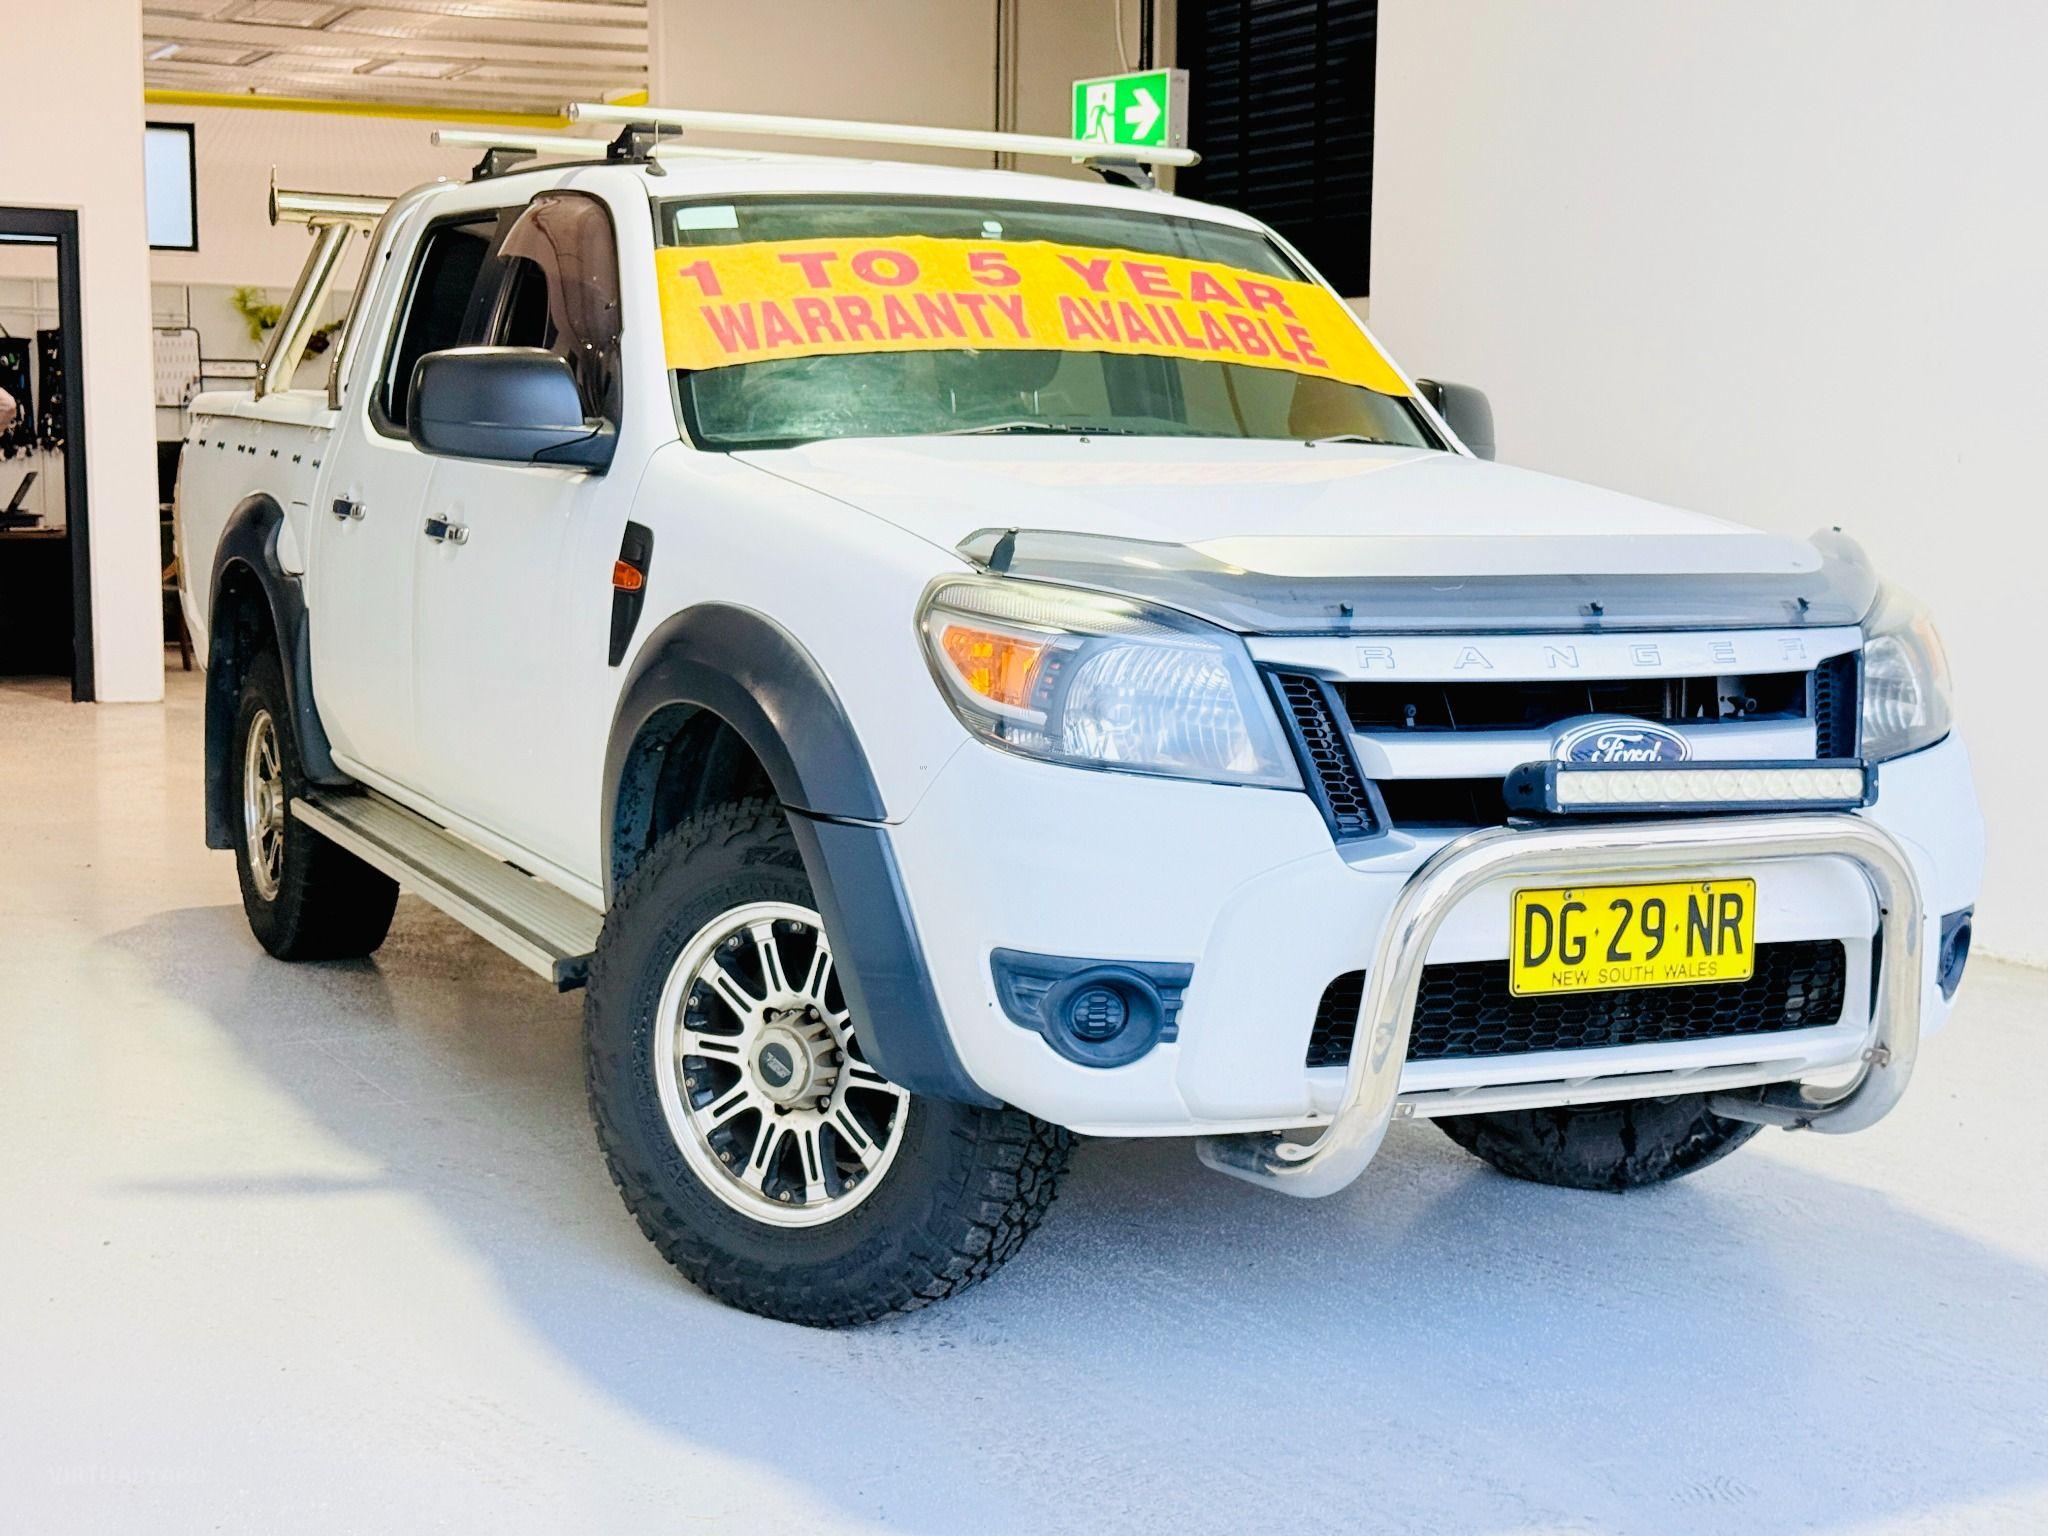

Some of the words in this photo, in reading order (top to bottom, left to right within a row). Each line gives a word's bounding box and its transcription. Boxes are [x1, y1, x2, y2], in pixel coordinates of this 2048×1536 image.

[679, 260, 722, 296] 1
[778, 251, 920, 288] TO
[968, 251, 1021, 286] 5
[1057, 256, 1301, 320] YEAR
[700, 292, 1031, 354] WARRANTY
[1059, 295, 1330, 370] AVAILABLE
[1355, 637, 1808, 670] RANGER
[1524, 902, 1588, 968] DG
[1606, 898, 1666, 962] 29
[1686, 893, 1744, 957] NR
[1551, 969, 1590, 987] NEW
[1598, 965, 1654, 984] SOUTH
[1664, 961, 1718, 978] WALES
